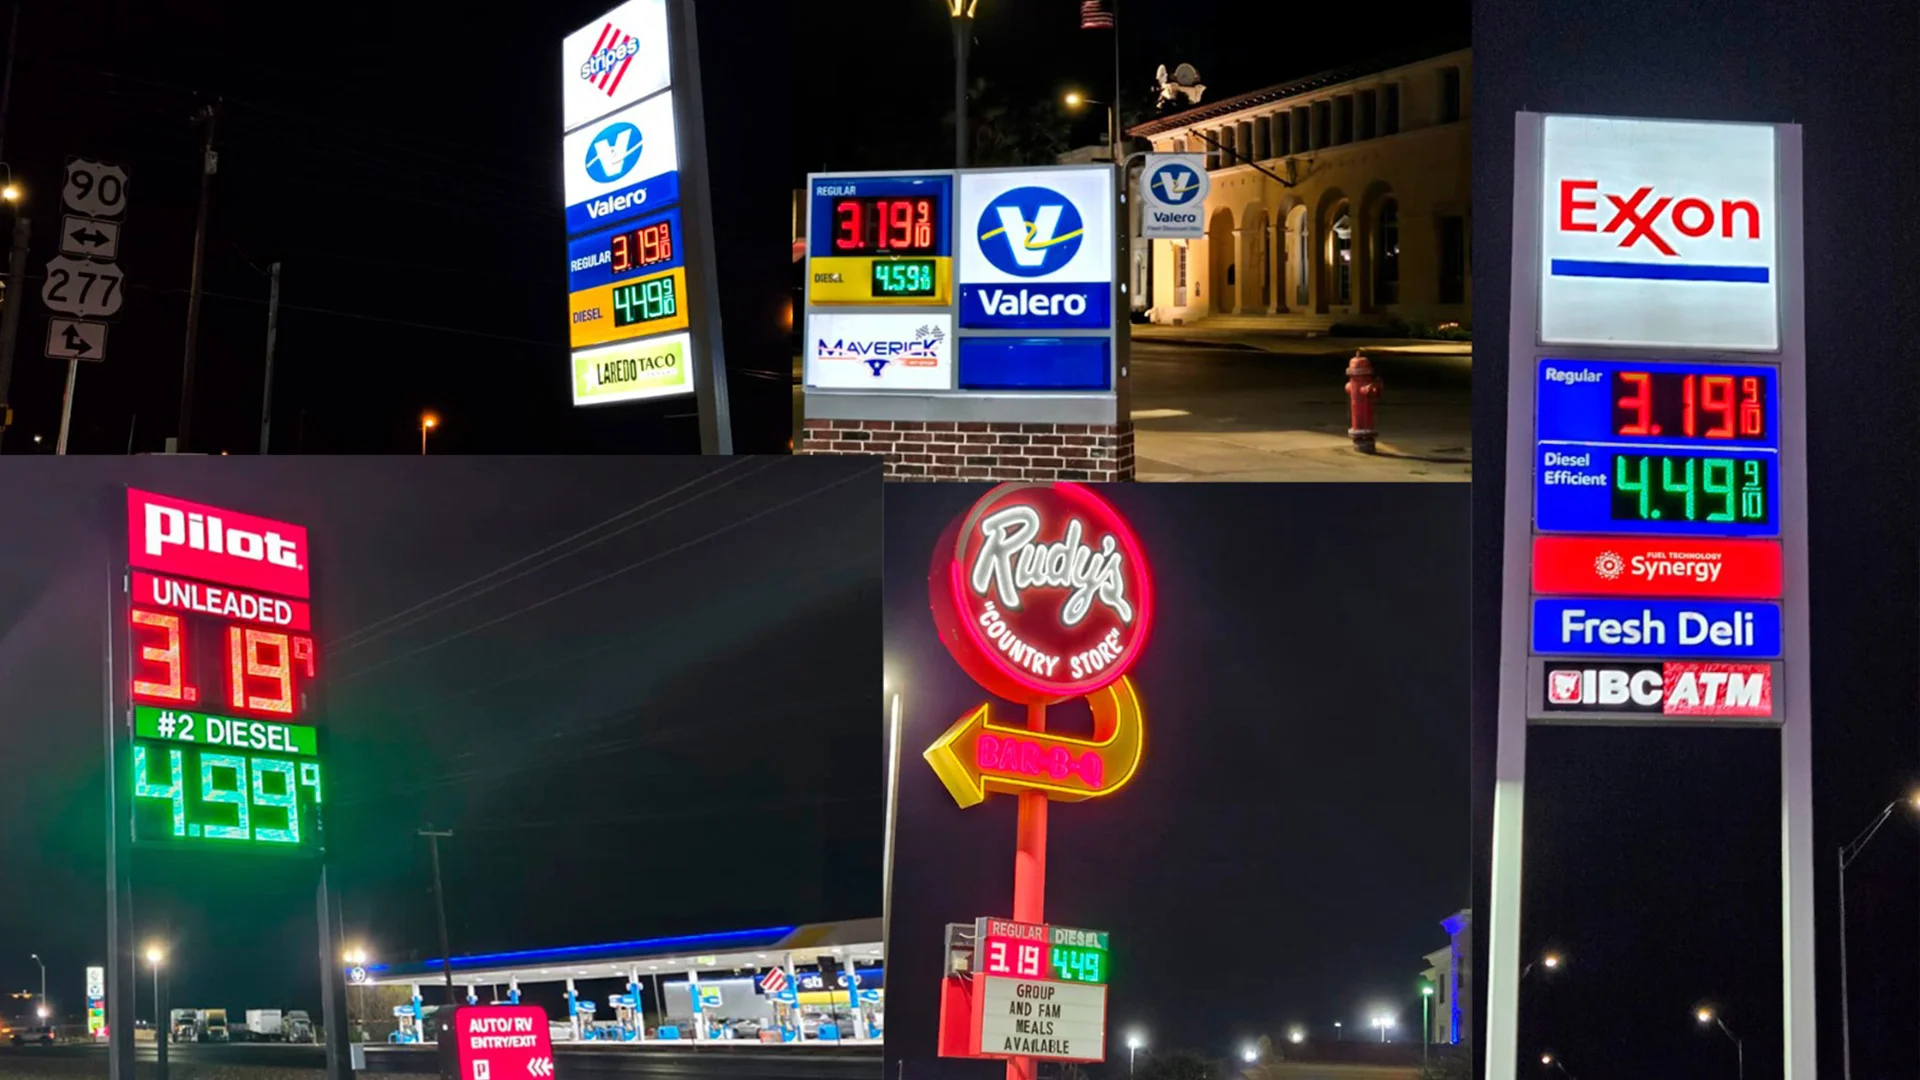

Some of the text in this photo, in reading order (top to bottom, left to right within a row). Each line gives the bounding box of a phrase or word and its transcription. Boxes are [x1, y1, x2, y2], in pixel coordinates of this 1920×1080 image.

[580, 37, 640, 80] stripes
[71, 170, 122, 206] 90
[587, 187, 647, 219] Valero
[816, 185, 856, 197] REGULAR
[836, 201, 912, 249] 3.19
[1154, 212, 1196, 223] Valero
[1560, 178, 1761, 257] Exxon
[571, 250, 611, 272] REGULAR
[613, 227, 660, 271] 3.19
[47, 268, 119, 308] 277
[876, 265, 919, 291] 4.59
[573, 308, 602, 324] DIESEL
[615, 281, 663, 323] 4.49
[977, 289, 1087, 317] Valero
[818, 338, 940, 357] MAVERICK
[597, 358, 638, 385] LAREDO
[638, 352, 676, 372] TACO
[1545, 367, 1603, 385] Regular
[1617, 371, 1735, 439] 3.19
[1544, 452, 1590, 467] Diesel
[1544, 470, 1607, 486] Efficient
[1616, 455, 1735, 521] 4.49
[972, 505, 1133, 626] Rudy's
[1631, 555, 1722, 582] Synergy
[1647, 551, 1722, 560] FUEL TECHNOLOGY
[153, 577, 293, 625] UNLEADED
[1561, 608, 1754, 646] Fresh Deli
[1582, 669, 1764, 707] IBC ATM
[158, 711, 299, 752] #2 DIESEL
[979, 734, 1103, 789] BAR-B-Q
[134, 746, 300, 843] 4.99
[992, 921, 1102, 948] REGULAR DIESEL
[990, 942, 1099, 982] 3.19 4.49
[1016, 983, 1055, 1000] GROUP
[514, 1017, 533, 1032] RV
[1009, 1001, 1061, 1018] AND FAM
[470, 1034, 537, 1050] ENTRY/EXIT
[1016, 1019, 1054, 1035] MEALS
[1004, 1037, 1069, 1054] AVAILABLE
